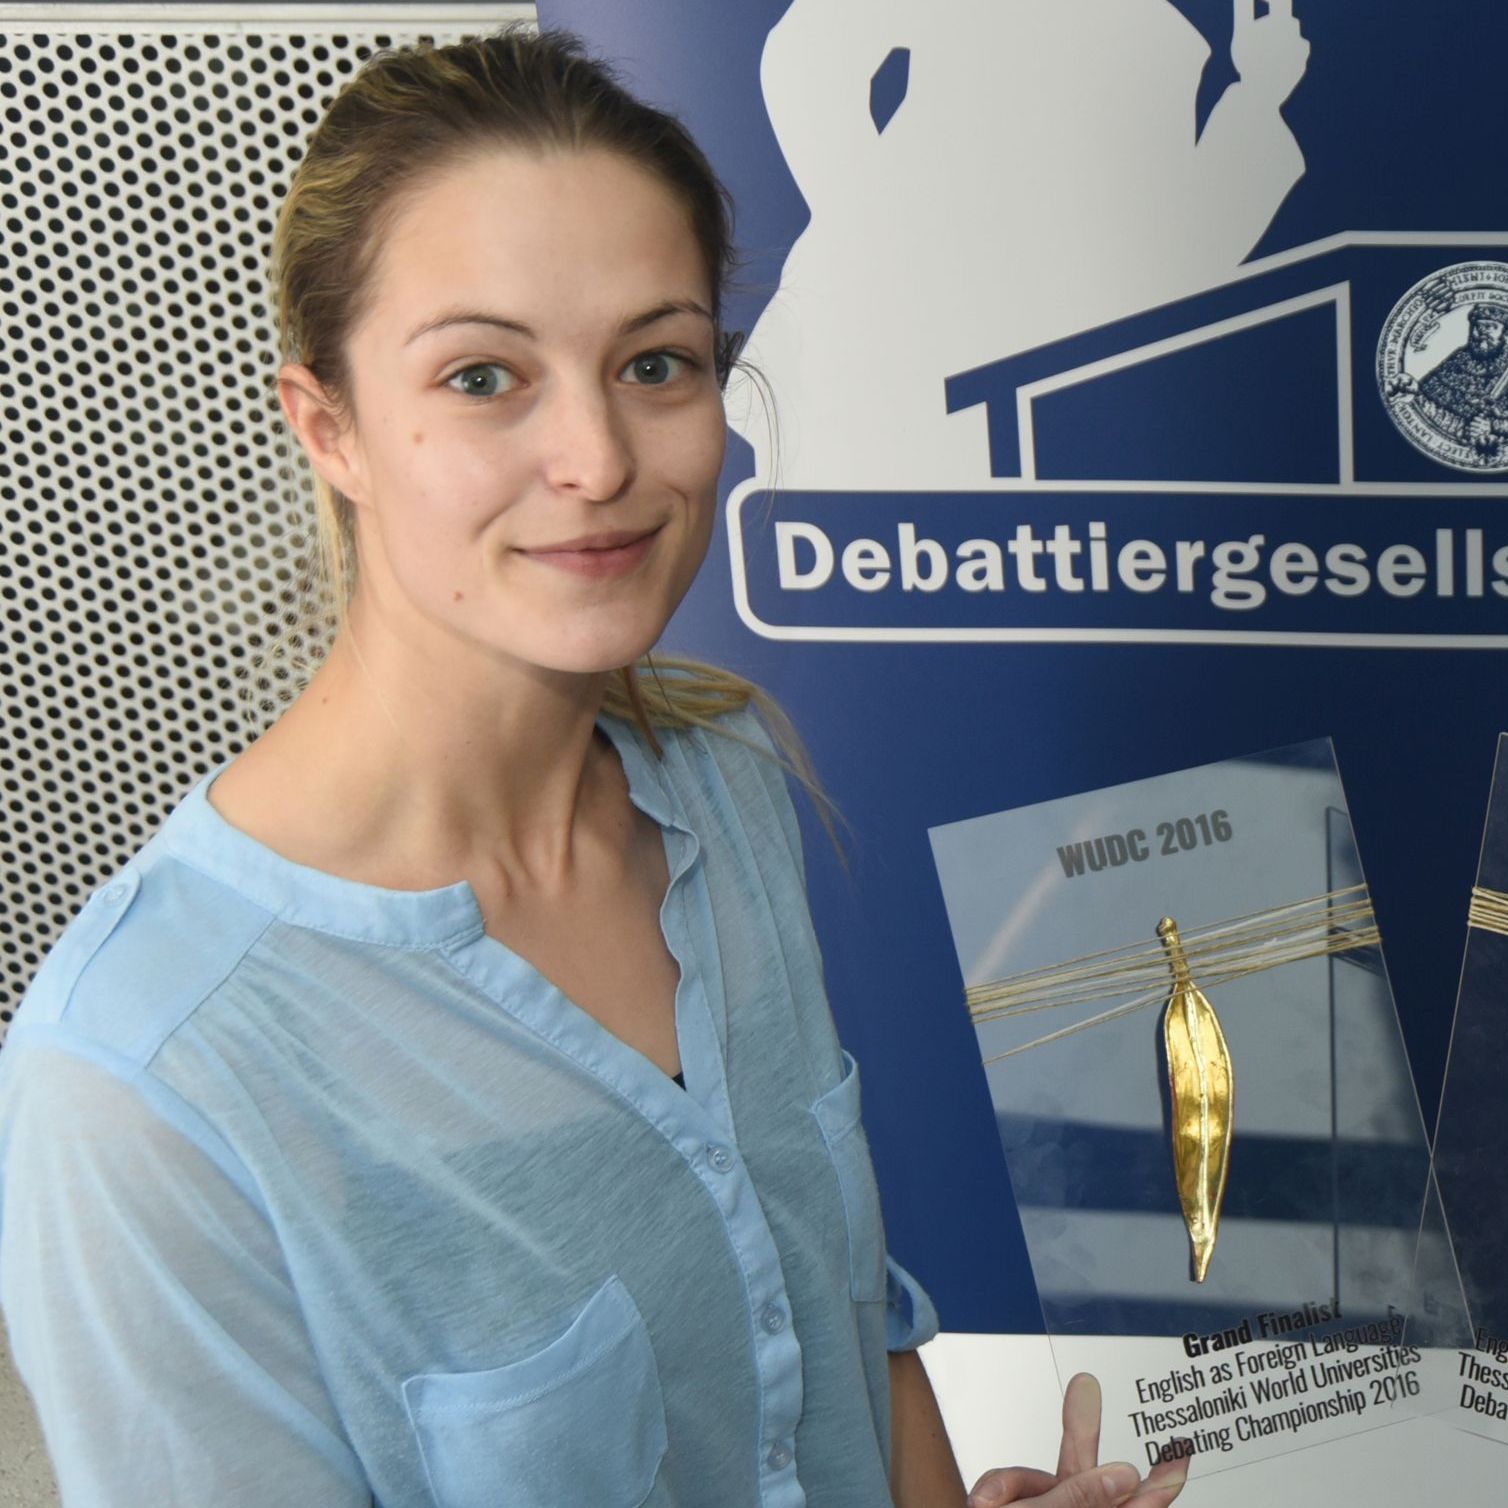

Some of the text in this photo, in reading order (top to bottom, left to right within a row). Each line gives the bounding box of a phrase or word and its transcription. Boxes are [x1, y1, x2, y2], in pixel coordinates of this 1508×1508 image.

[1056, 809, 1233, 878] WUDC 2016
[1183, 1297, 1343, 1358] Grand Finalist
[1128, 1342, 1422, 1438] Thessaloniki World Universities
[1135, 1366, 1206, 1404] English
[1209, 1361, 1233, 1385] as
[1235, 1341, 1308, 1377] Foreign
[1145, 1370, 1421, 1467] Debating Championship 2016
